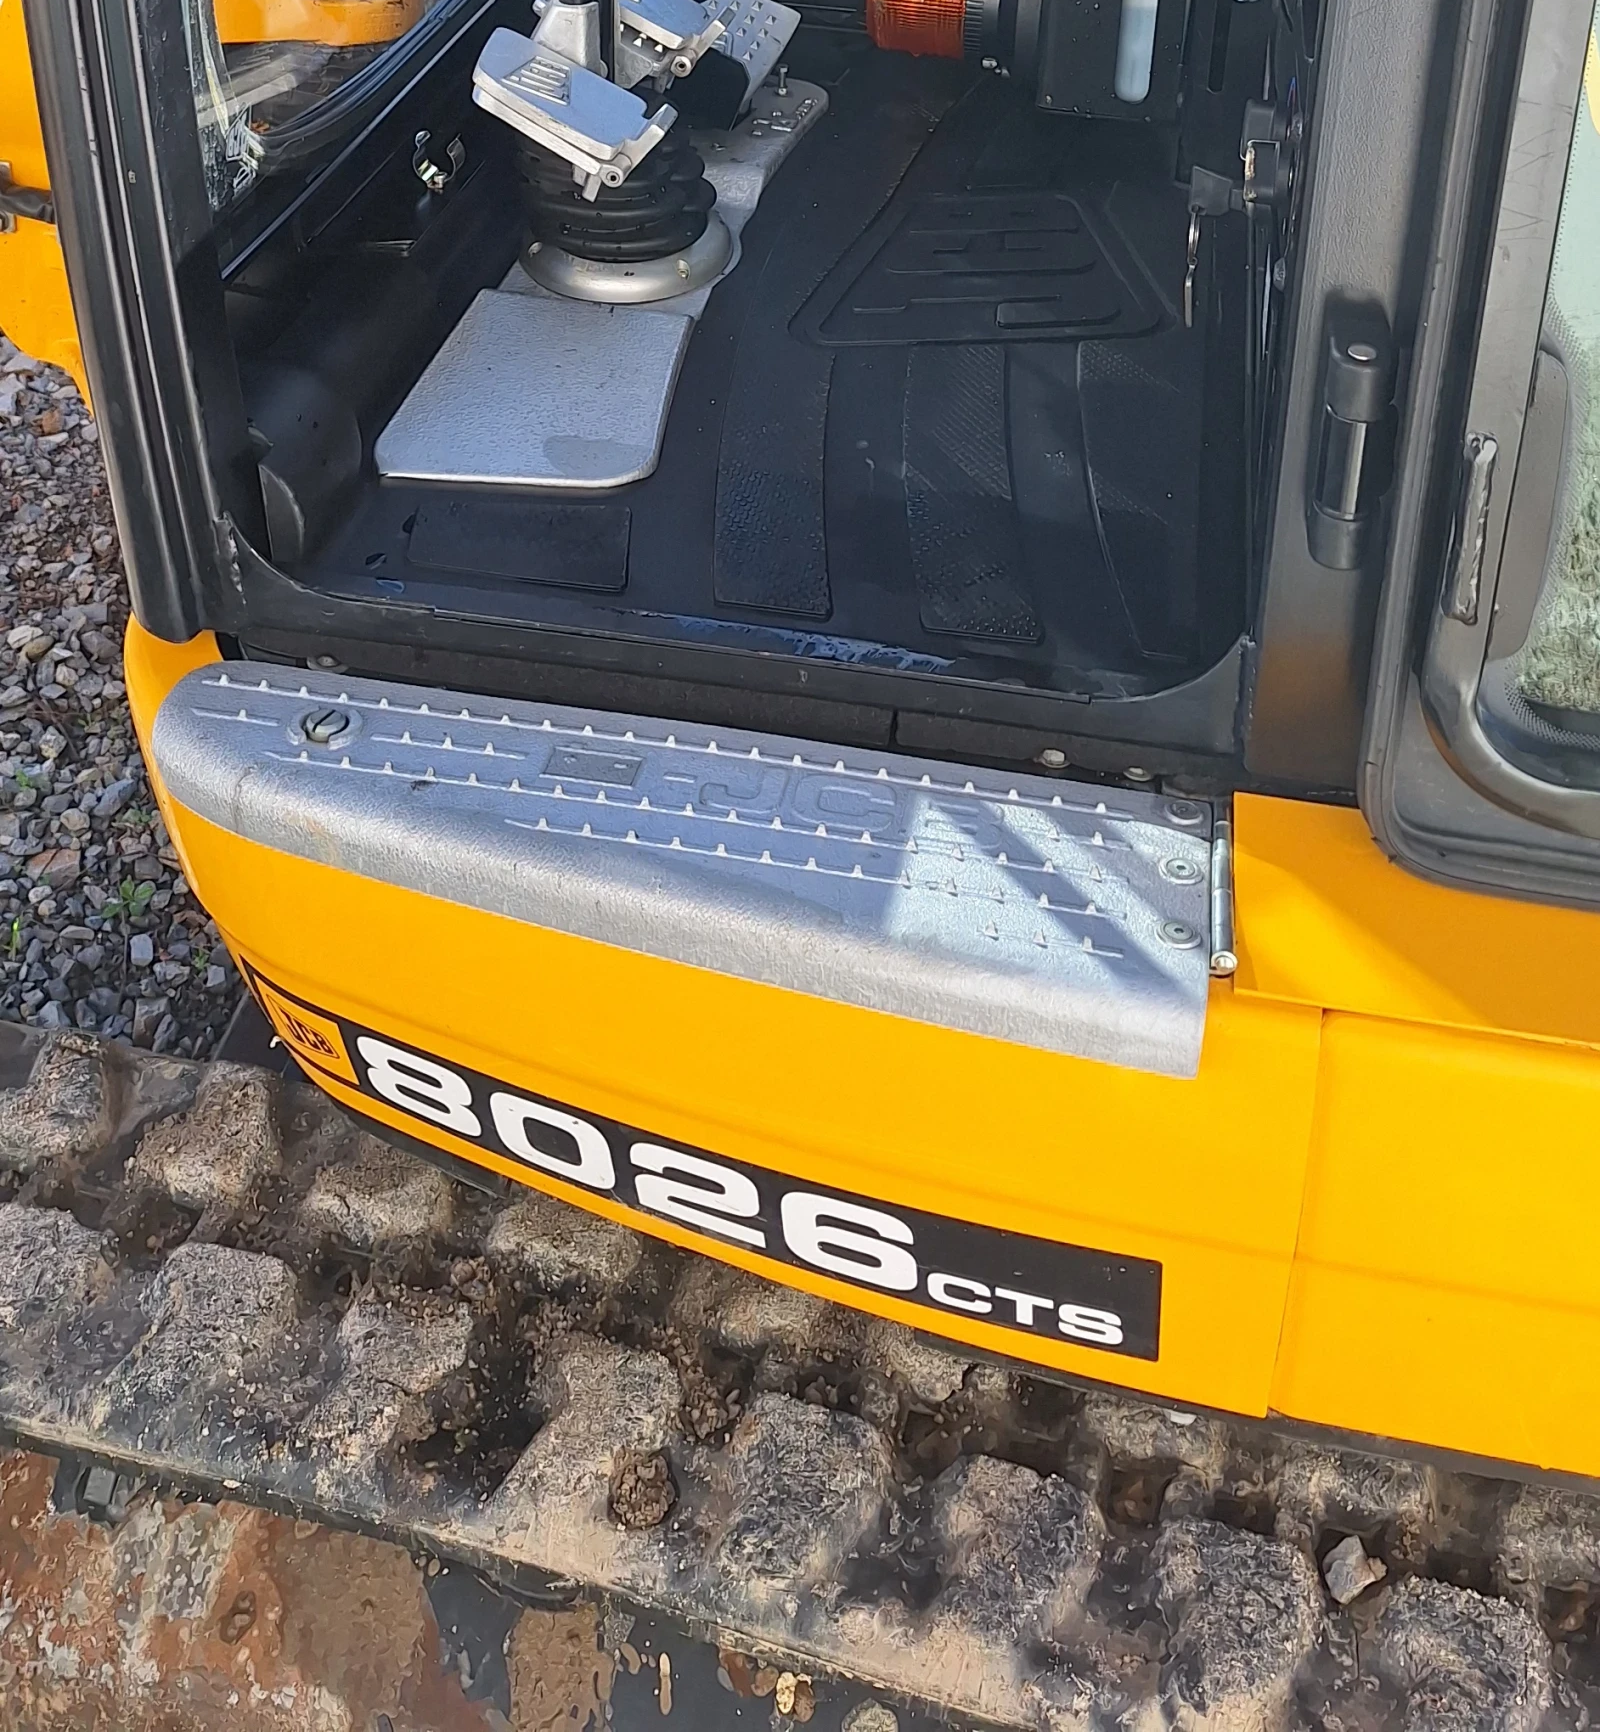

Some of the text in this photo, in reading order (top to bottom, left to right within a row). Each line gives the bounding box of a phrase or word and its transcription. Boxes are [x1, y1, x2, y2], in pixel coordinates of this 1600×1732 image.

[700, 768, 1005, 852] JCB
[278, 1006, 335, 1056] JCB
[356, 1035, 1125, 1346] 8026 CTS
